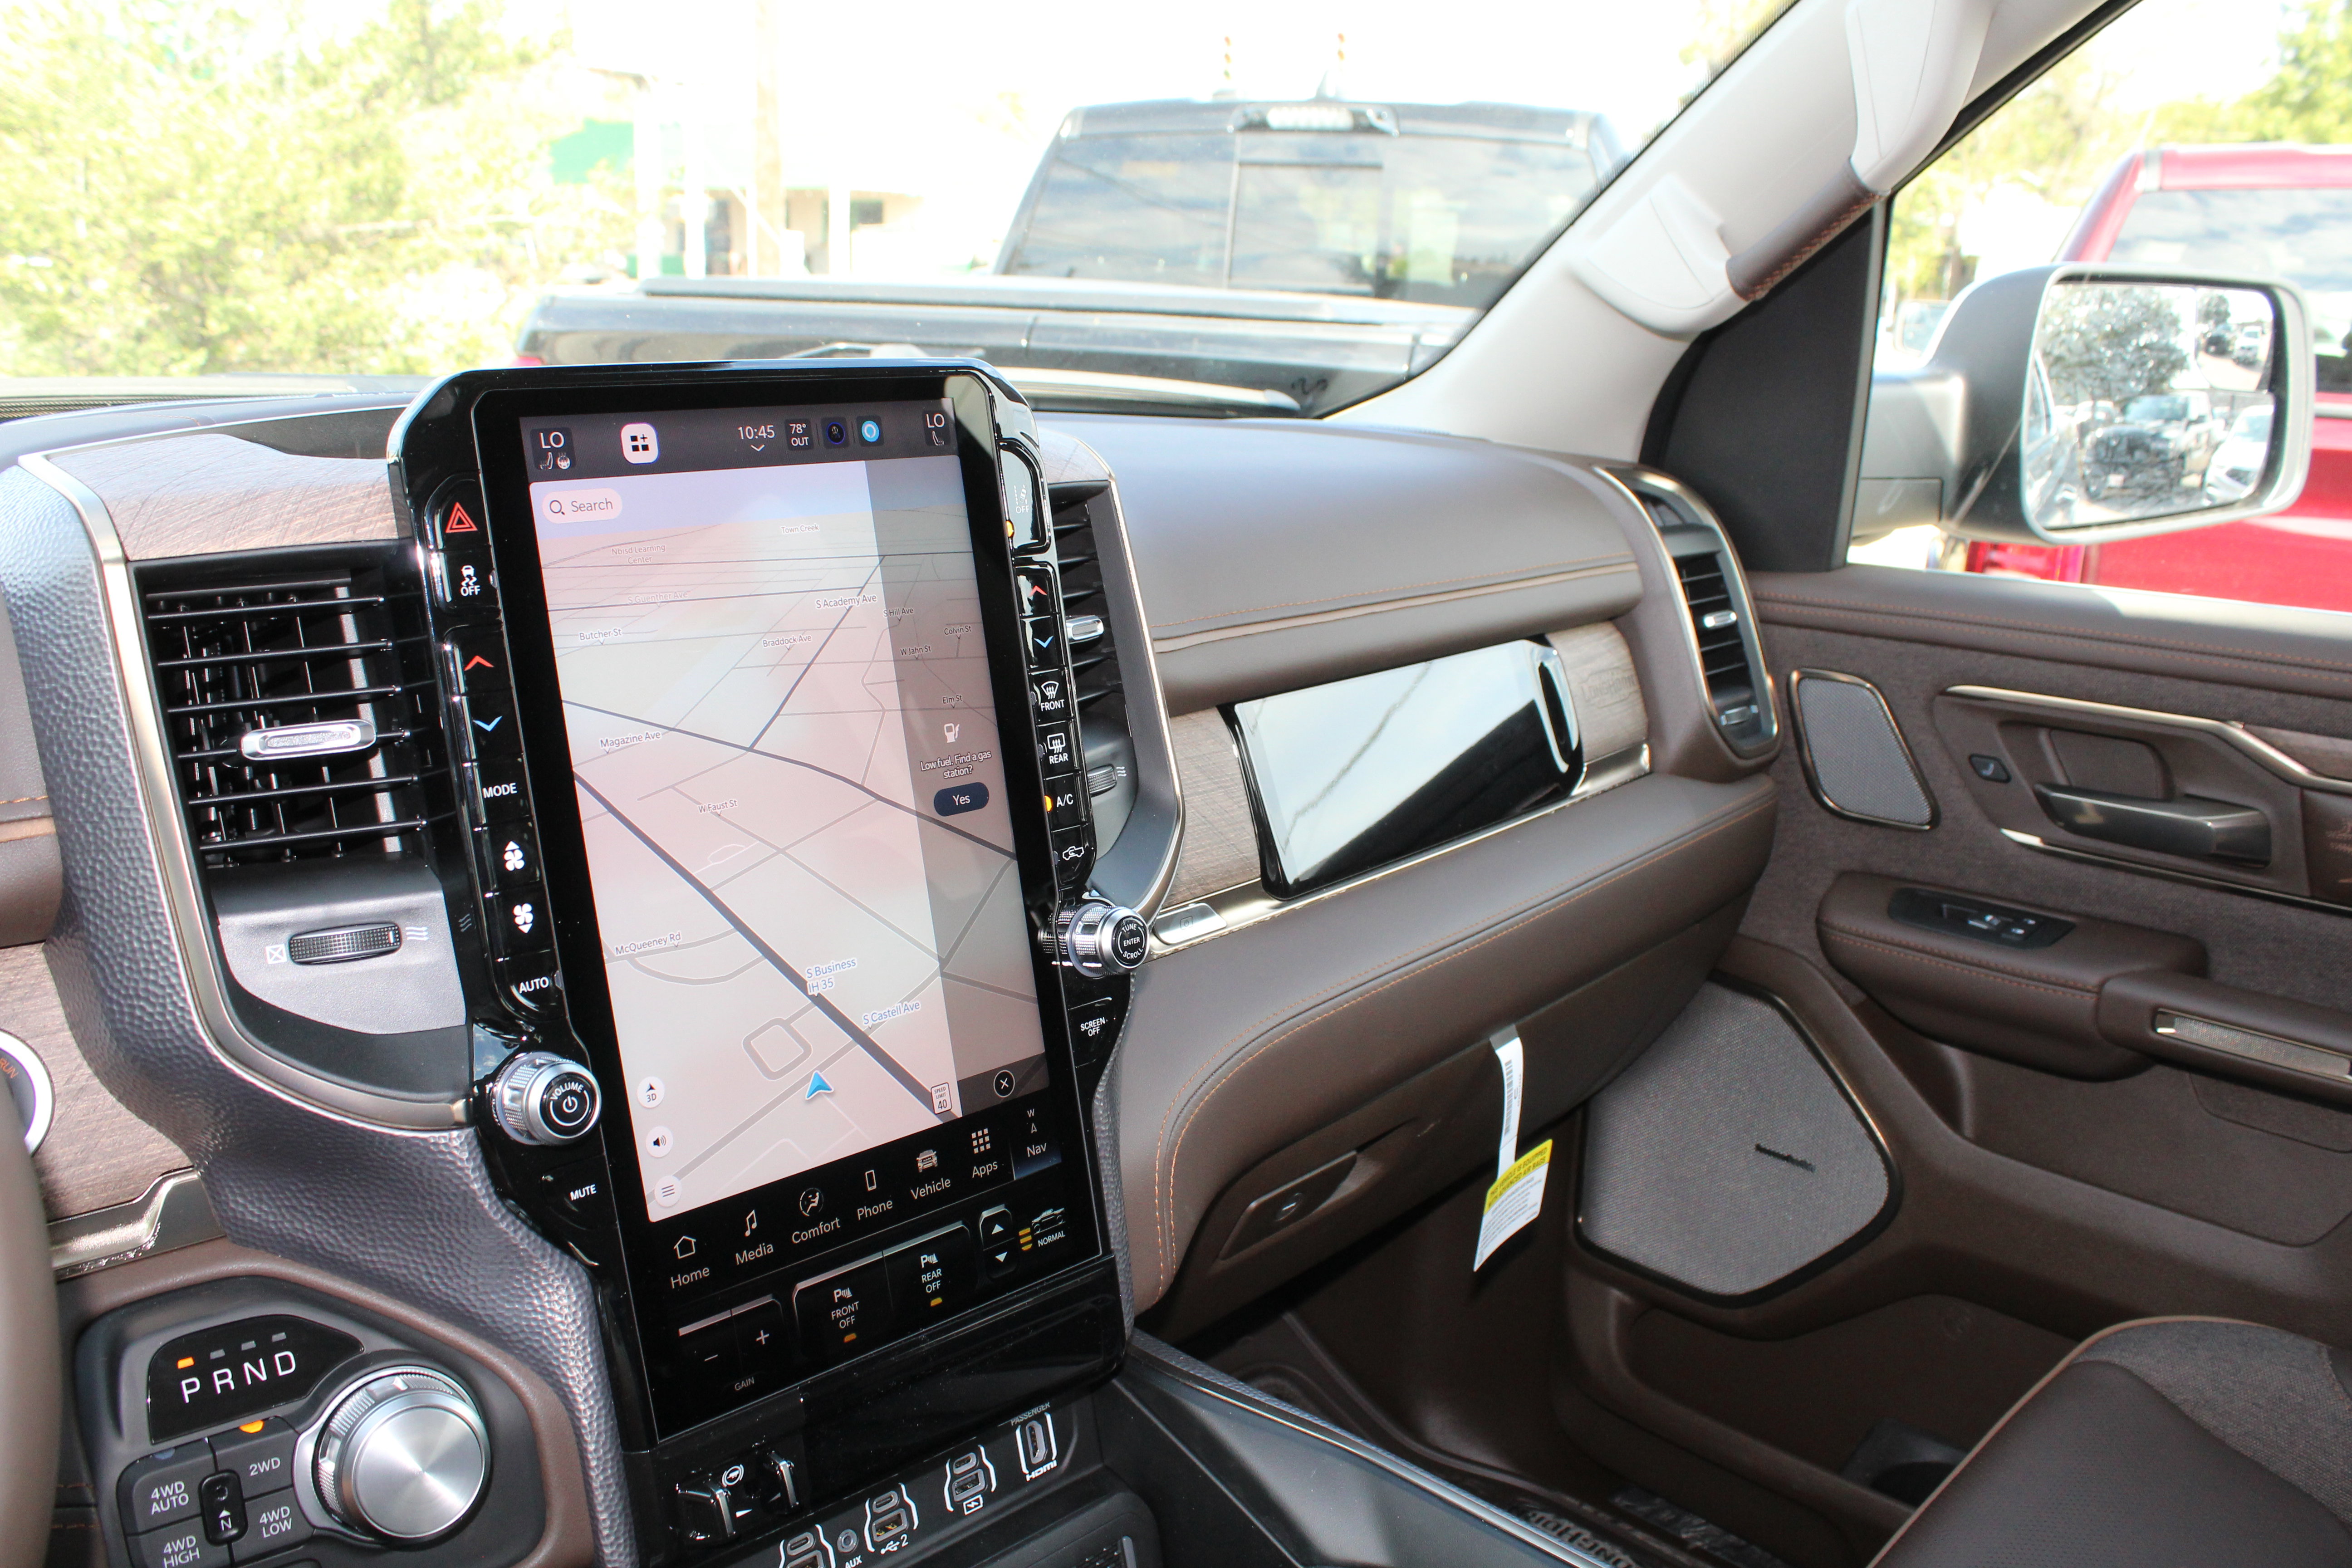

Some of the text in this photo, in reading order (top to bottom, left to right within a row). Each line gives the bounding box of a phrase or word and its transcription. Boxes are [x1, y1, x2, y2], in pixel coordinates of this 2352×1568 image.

[926, 414, 945, 428] LO
[539, 431, 564, 448] LO
[737, 425, 775, 440] 10:45
[791, 437, 808, 446] OUT
[571, 498, 613, 513] Search
[781, 524, 819, 534] Town Creek
[612, 544, 666, 555] Nbisd Learning
[628, 555, 652, 564] Center
[461, 585, 480, 596] OFF
[628, 591, 688, 604] S Guenther Ave
[816, 594, 877, 608] S Academy Ave
[889, 608, 900, 616] Hill
[579, 628, 622, 641] Butcher St
[944, 627, 964, 636] Colvin
[763, 634, 812, 647] Braddock Ave
[907, 647, 923, 655] Jahn
[924, 645, 931, 653] St
[943, 696, 954, 704] Elm
[1041, 700, 1064, 711] FRONT
[600, 731, 661, 748] Magazine Ave
[920, 760, 937, 772] Low
[938, 757, 953, 769] fuel.
[955, 754, 970, 765] Find
[977, 750, 991, 763] gas
[1049, 753, 1068, 764] REAR
[944, 764, 973, 779] station?
[483, 783, 517, 799] MODE
[698, 799, 738, 813] W Faust St
[953, 794, 970, 805] Yes
[1056, 794, 1073, 808] A/C
[1122, 923, 1137, 933] TUNE
[615, 931, 681, 955] McQueeney Rd
[1123, 936, 1140, 946] ENTER
[1123, 948, 1143, 959] SCROLL
[806, 958, 857, 979] S Business
[519, 977, 549, 993] AUTO
[808, 978, 834, 993] IH 35
[863, 1000, 920, 1025] S Castell Ave
[1080, 1017, 1105, 1031] SCREEN
[1088, 1027, 1100, 1037] OFF
[551, 1081, 583, 1101] VOLUME
[647, 1093, 657, 1102] 3D
[938, 1099, 947, 1109] 40
[1027, 1109, 1034, 1117] W
[1027, 1142, 1047, 1157] Nav
[972, 1160, 998, 1178] Apps
[570, 1184, 597, 1201] MUTE
[911, 1178, 951, 1200] Vehicle
[857, 1199, 893, 1220] Phone
[792, 1217, 840, 1244] Comfort
[1038, 1231, 1065, 1247] NORMAL
[736, 1243, 774, 1265] Media
[671, 1267, 710, 1289] Home
[921, 1269, 942, 1284] REAR
[926, 1280, 941, 1293] OFF
[831, 1301, 859, 1320] FRONT
[839, 1315, 855, 1329] OFF
[735, 1377, 754, 1391] GAIN
[1010, 1402, 1050, 1426] PASSENGER
[250, 1457, 281, 1476] 2WD
[1026, 1460, 1057, 1481] HDMI
[151, 1480, 185, 1500] 4WD
[151, 1493, 189, 1515] AUTO
[260, 1506, 290, 1524] 4WD
[221, 1518, 232, 1530] N
[262, 1518, 293, 1538] LOW
[163, 1535, 196, 1554] 4WD
[901, 1534, 908, 1547] 2
[163, 1549, 200, 1568] HIGH
[845, 1555, 862, 1568] AUX
